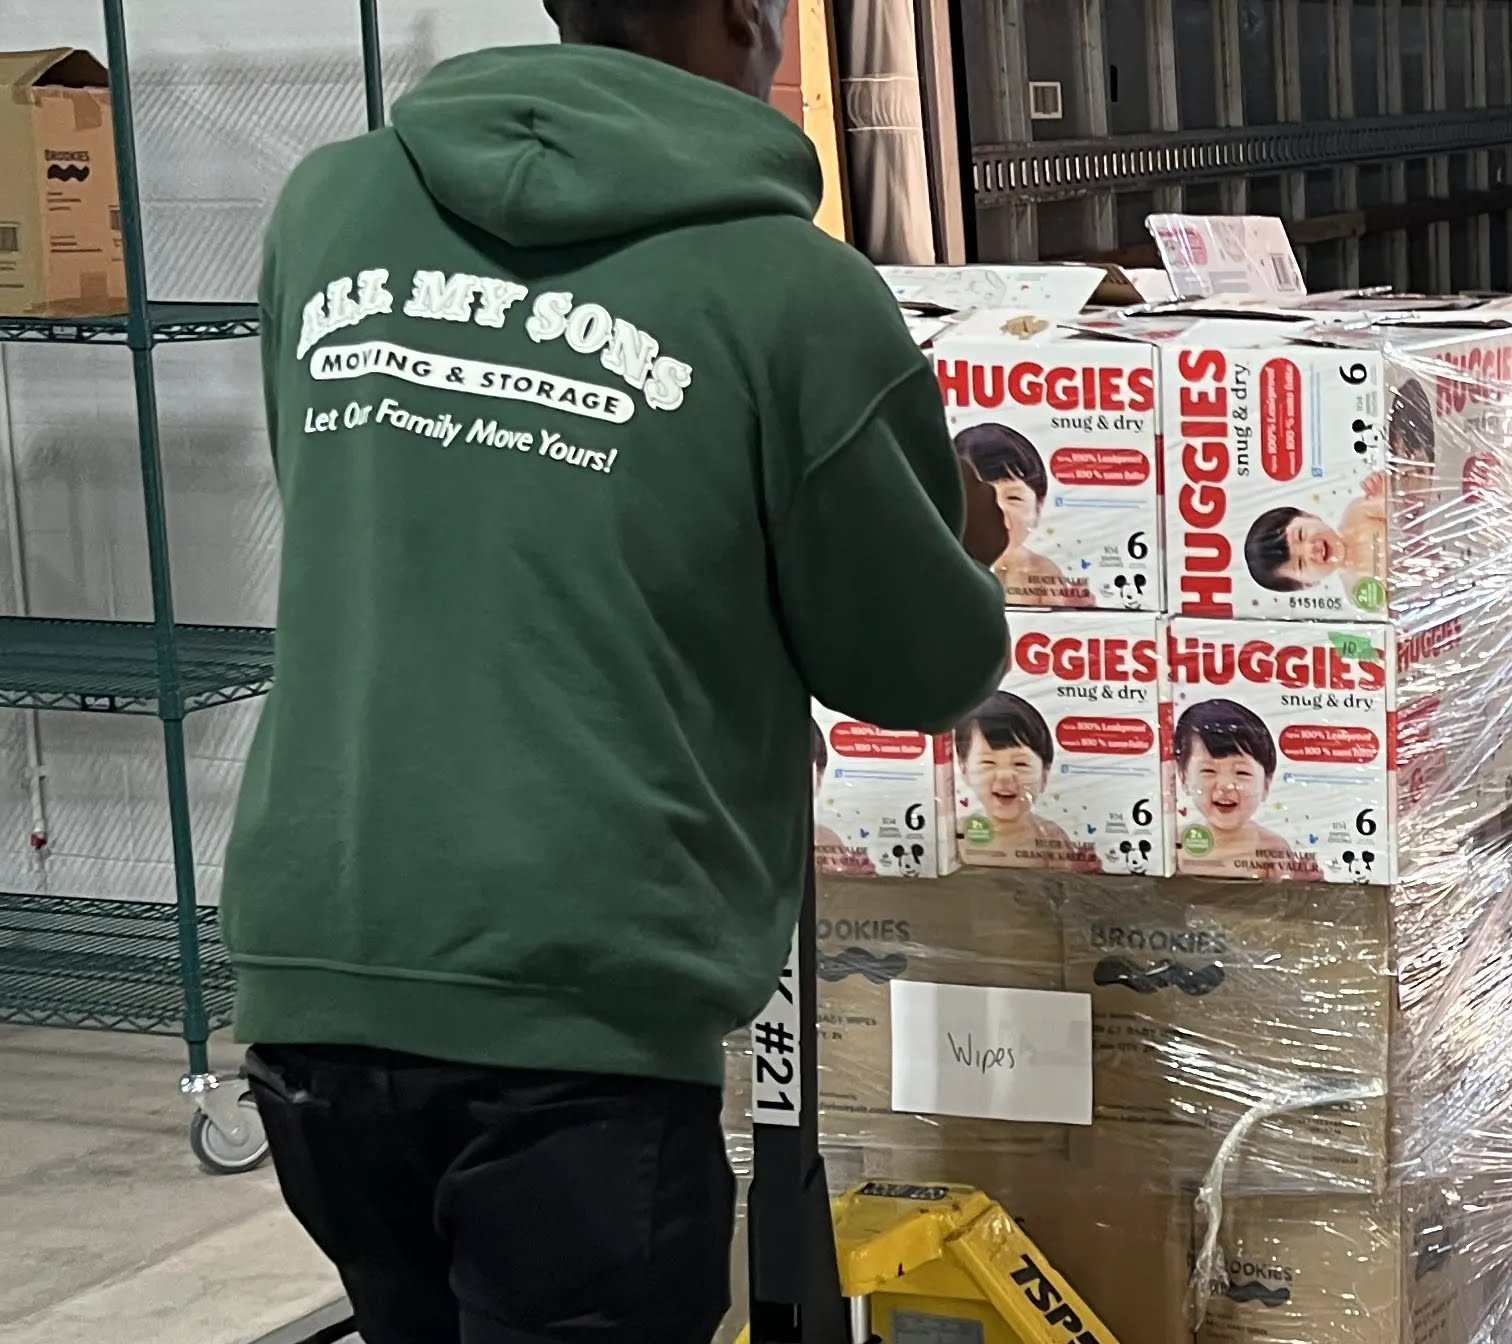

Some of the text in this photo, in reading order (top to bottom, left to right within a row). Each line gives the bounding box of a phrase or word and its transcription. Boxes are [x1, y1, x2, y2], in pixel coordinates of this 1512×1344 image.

[403, 269, 529, 329] MY
[525, 291, 694, 412] SONS
[320, 347, 622, 417] MOVING & STORAGE
[937, 359, 1155, 413] HUGGIES
[1339, 362, 1368, 385] 6
[1051, 414, 1145, 434] snug & dry
[1230, 362, 1252, 477] snug & dry
[304, 407, 339, 433] Let
[375, 398, 462, 447] Family
[466, 418, 534, 452] Move
[538, 429, 619, 474] Yours!
[1178, 348, 1234, 620] HUGGIES
[1127, 530, 1149, 560] 6
[1010, 631, 1158, 683] GGIES
[1167, 625, 1387, 692] HUGGIES
[1056, 683, 1148, 703] snug & dry
[1281, 693, 1375, 713] snug & dry
[904, 803, 926, 831] 6
[1131, 798, 1153, 827] 6
[1355, 808, 1377, 836] 6
[817, 919, 911, 942] OOKIES
[1091, 924, 1228, 954] BROOKIES
[755, 1021, 795, 1112] #21
[948, 1032, 1017, 1075] Wipes
[1229, 1260, 1293, 1282] OOKIES
